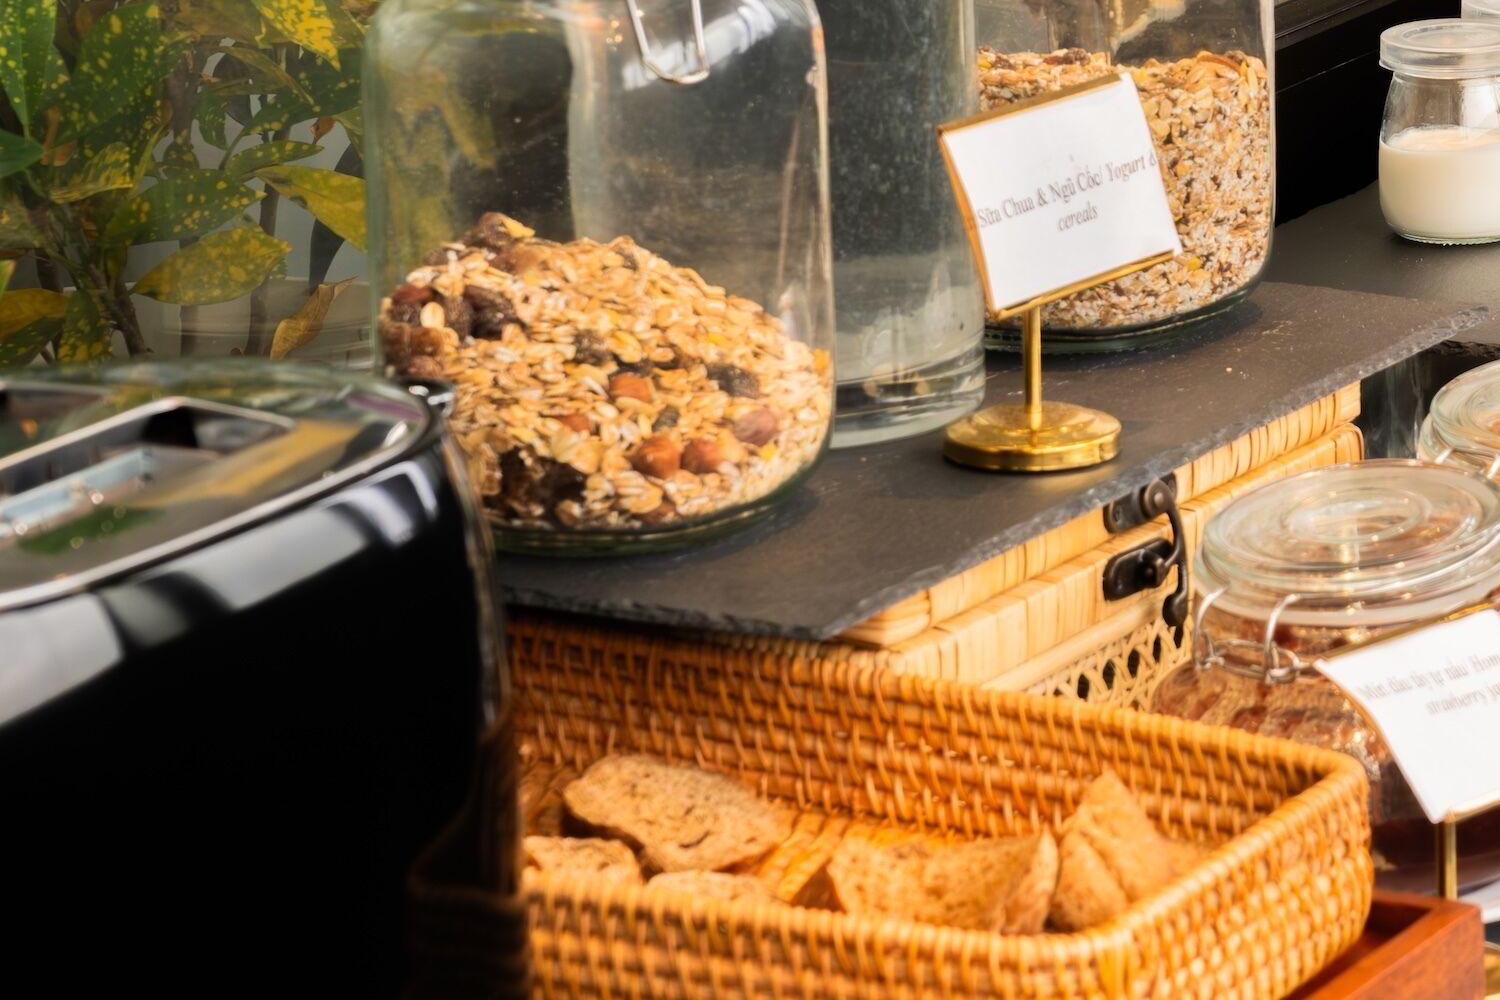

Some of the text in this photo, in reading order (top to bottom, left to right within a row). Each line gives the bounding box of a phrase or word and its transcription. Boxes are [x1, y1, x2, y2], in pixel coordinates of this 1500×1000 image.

[1002, 194, 1036, 219] Chua
[1036, 184, 1049, 207] &
[1104, 156, 1146, 182] Yogurt
[1057, 200, 1100, 232] cereals
